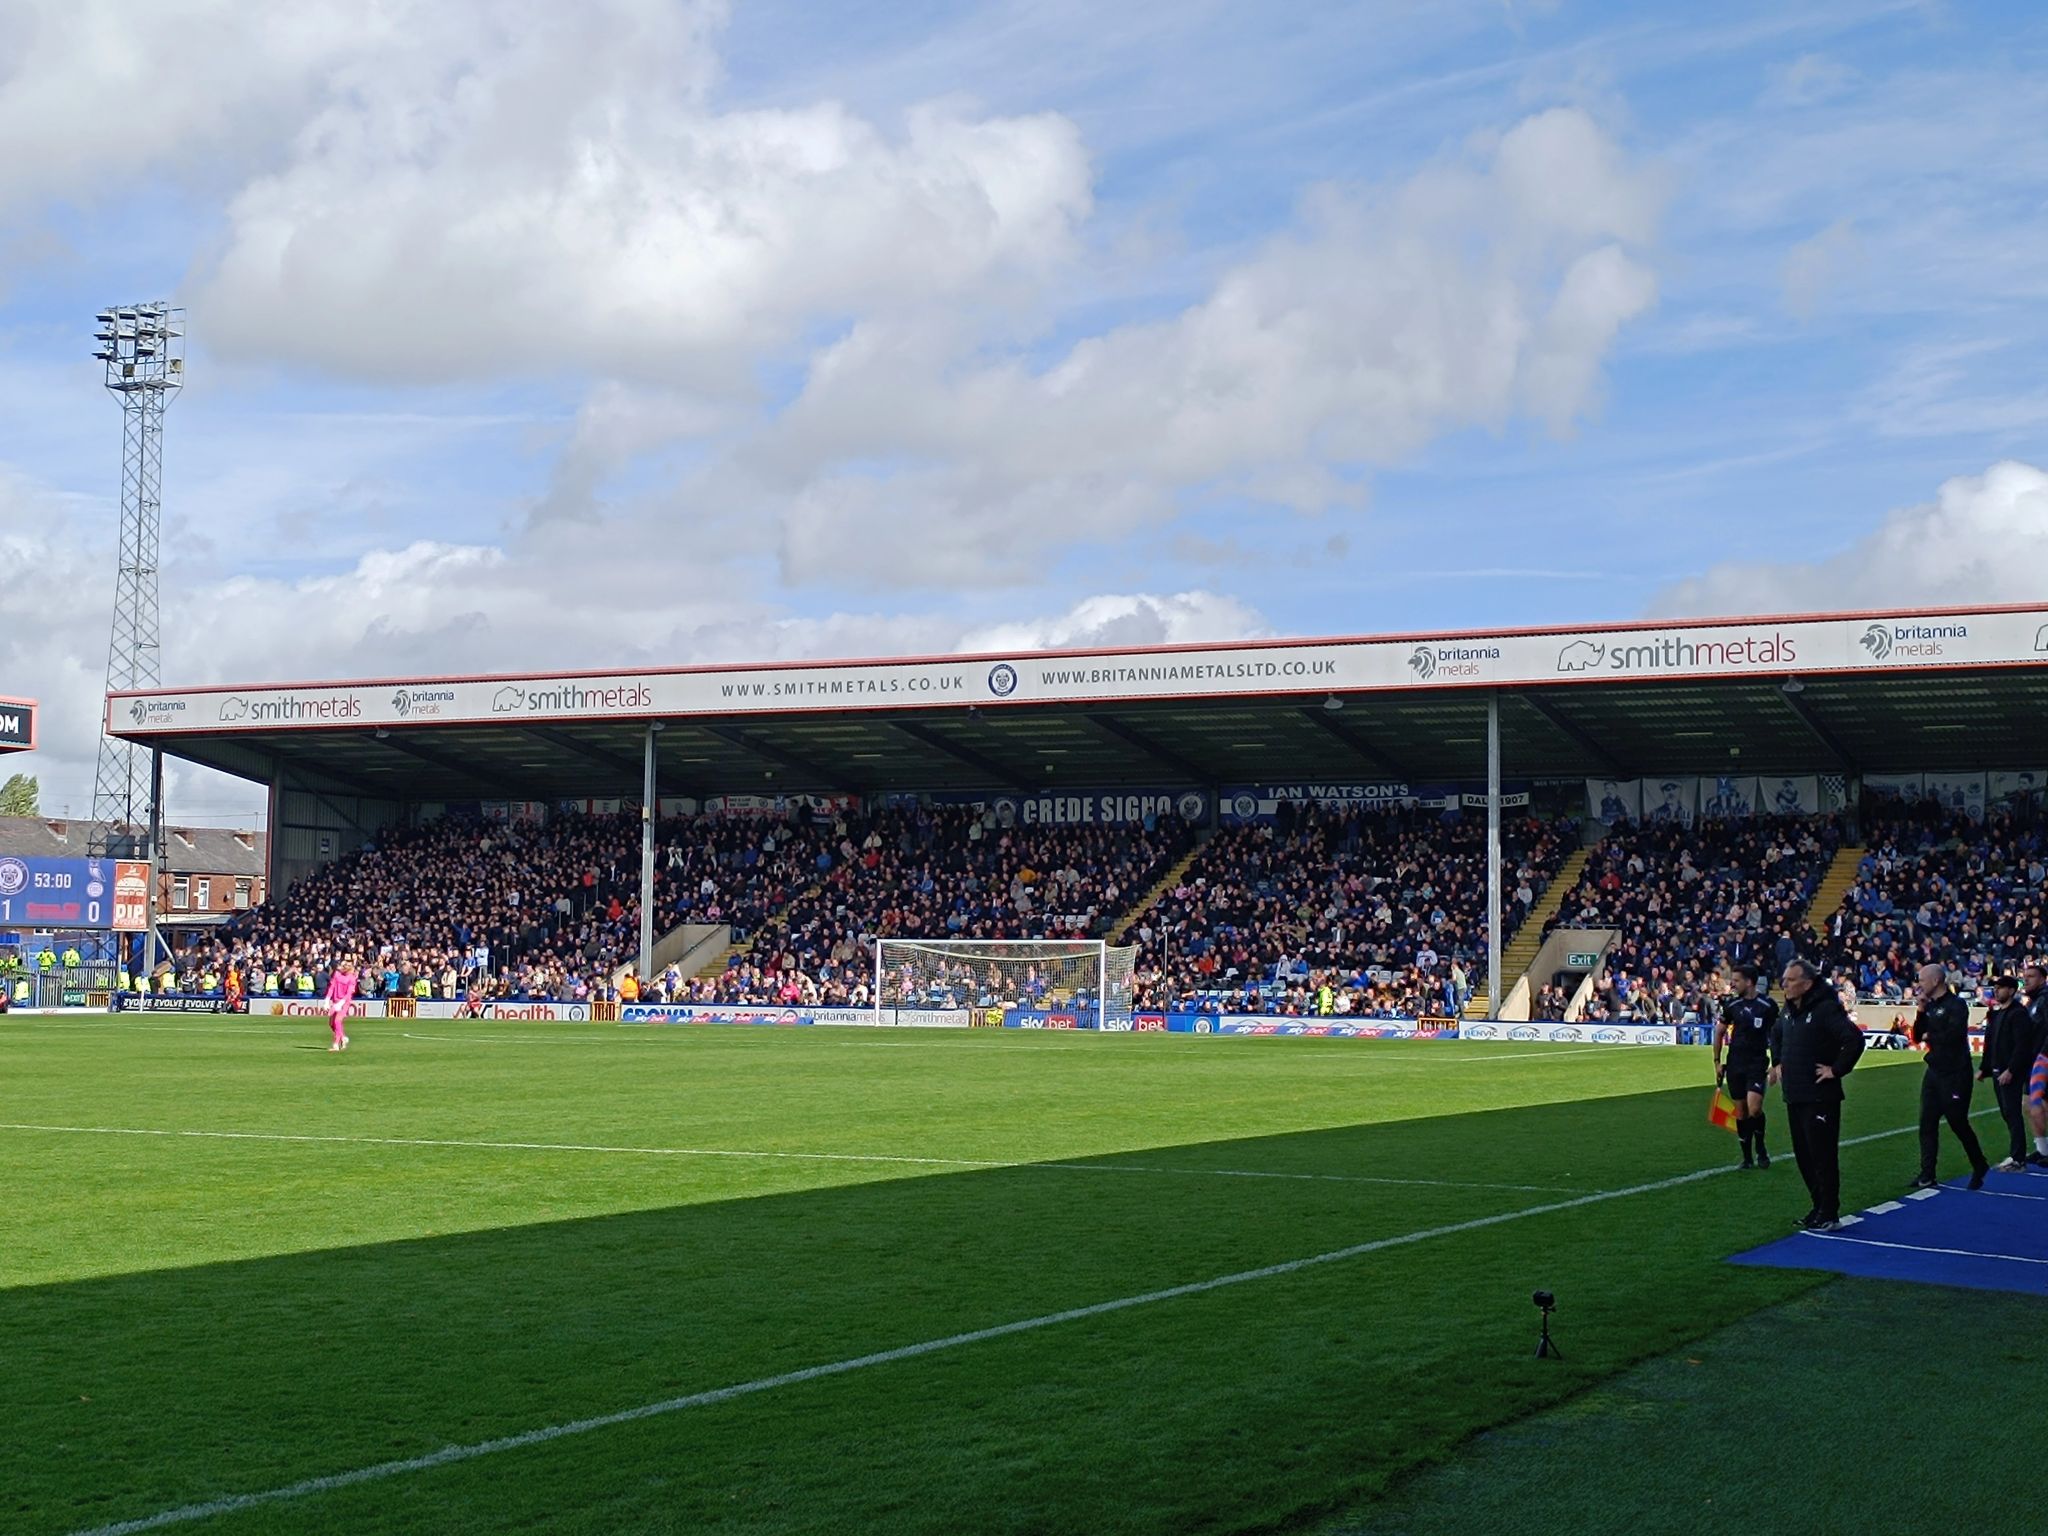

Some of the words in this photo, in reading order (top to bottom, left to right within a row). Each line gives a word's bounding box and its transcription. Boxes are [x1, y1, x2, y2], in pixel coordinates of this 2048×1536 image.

[1895, 624, 1967, 640] britannia
[1438, 646, 1500, 661] britannia
[1610, 632, 1796, 670] smithmetals
[1895, 642, 1943, 656] metals
[1042, 660, 1336, 685] WWW.BRITANNIAMETALSLTD.CO.UK
[1438, 662, 1479, 676] metals
[722, 676, 964, 697] WWW.SMITHMETALS.CO.UK
[412, 689, 455, 702] britannia
[528, 682, 652, 710] smithmetals
[147, 700, 186, 711] britannia
[251, 694, 362, 719] smithmetals
[412, 703, 440, 715] metals
[147, 714, 173, 724] metals
[1268, 786, 1302, 799] IAN
[1309, 784, 1409, 798] WATSON'S
[1467, 796, 1489, 805] DAL
[1023, 797, 1094, 824] CREDE
[34, 872, 72, 889] 53:00
[1, 899, 11, 921] 1
[88, 901, 100, 923] 0
[115, 903, 144, 920] DIP
[1569, 955, 1592, 965] Exit
[123, 998, 152, 1007] EVOVE
[185, 999, 215, 1009] EVOLVE
[494, 1004, 555, 1020] health
[814, 1010, 886, 1022] britanniametls
[1021, 1016, 1044, 1029] sky
[1048, 1017, 1072, 1029] bet
[1108, 1017, 1133, 1031] sky
[1138, 1018, 1164, 1031] bet
[1464, 1029, 1498, 1037] BENVIC
[1506, 1030, 1540, 1038] BENVIC
[1549, 1032, 1582, 1040] BENVIC
[1591, 1033, 1626, 1041] BENVIC
[1635, 1034, 1671, 1042] BENVIC
